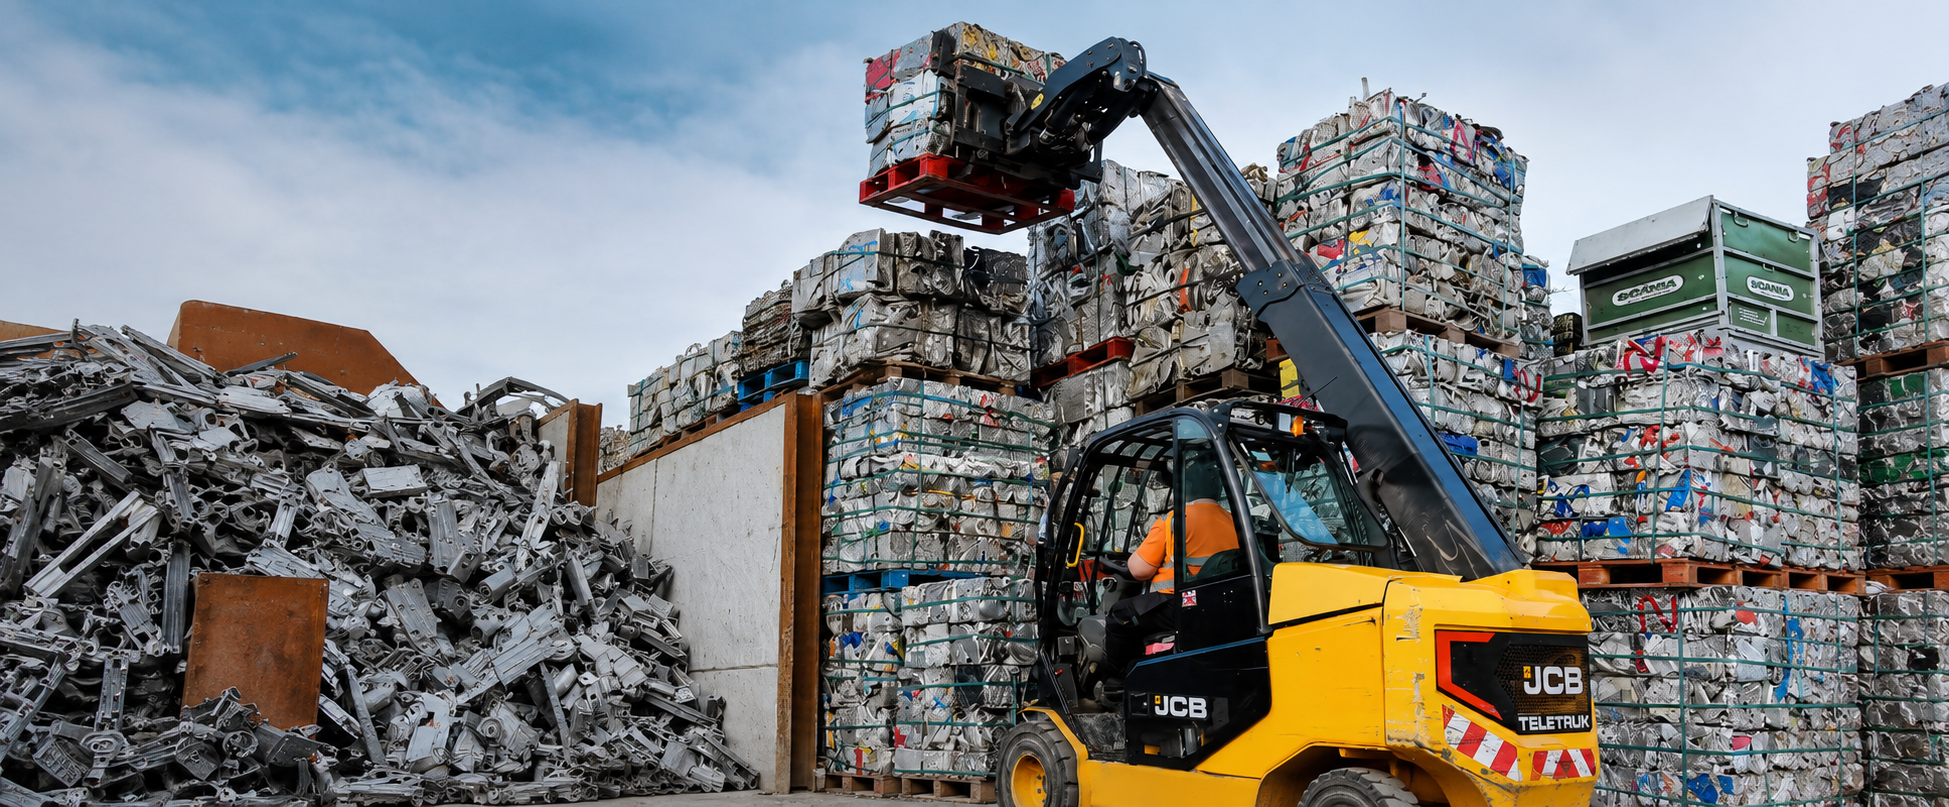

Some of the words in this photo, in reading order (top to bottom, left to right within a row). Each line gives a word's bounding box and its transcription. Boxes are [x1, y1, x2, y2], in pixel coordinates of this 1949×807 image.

[1617, 278, 1677, 302] SCANIA
[1750, 279, 1790, 297] SCANIA
[1522, 665, 1584, 695] JCB
[1154, 695, 1208, 719] JCB
[1518, 715, 1590, 731] TELETRUK
